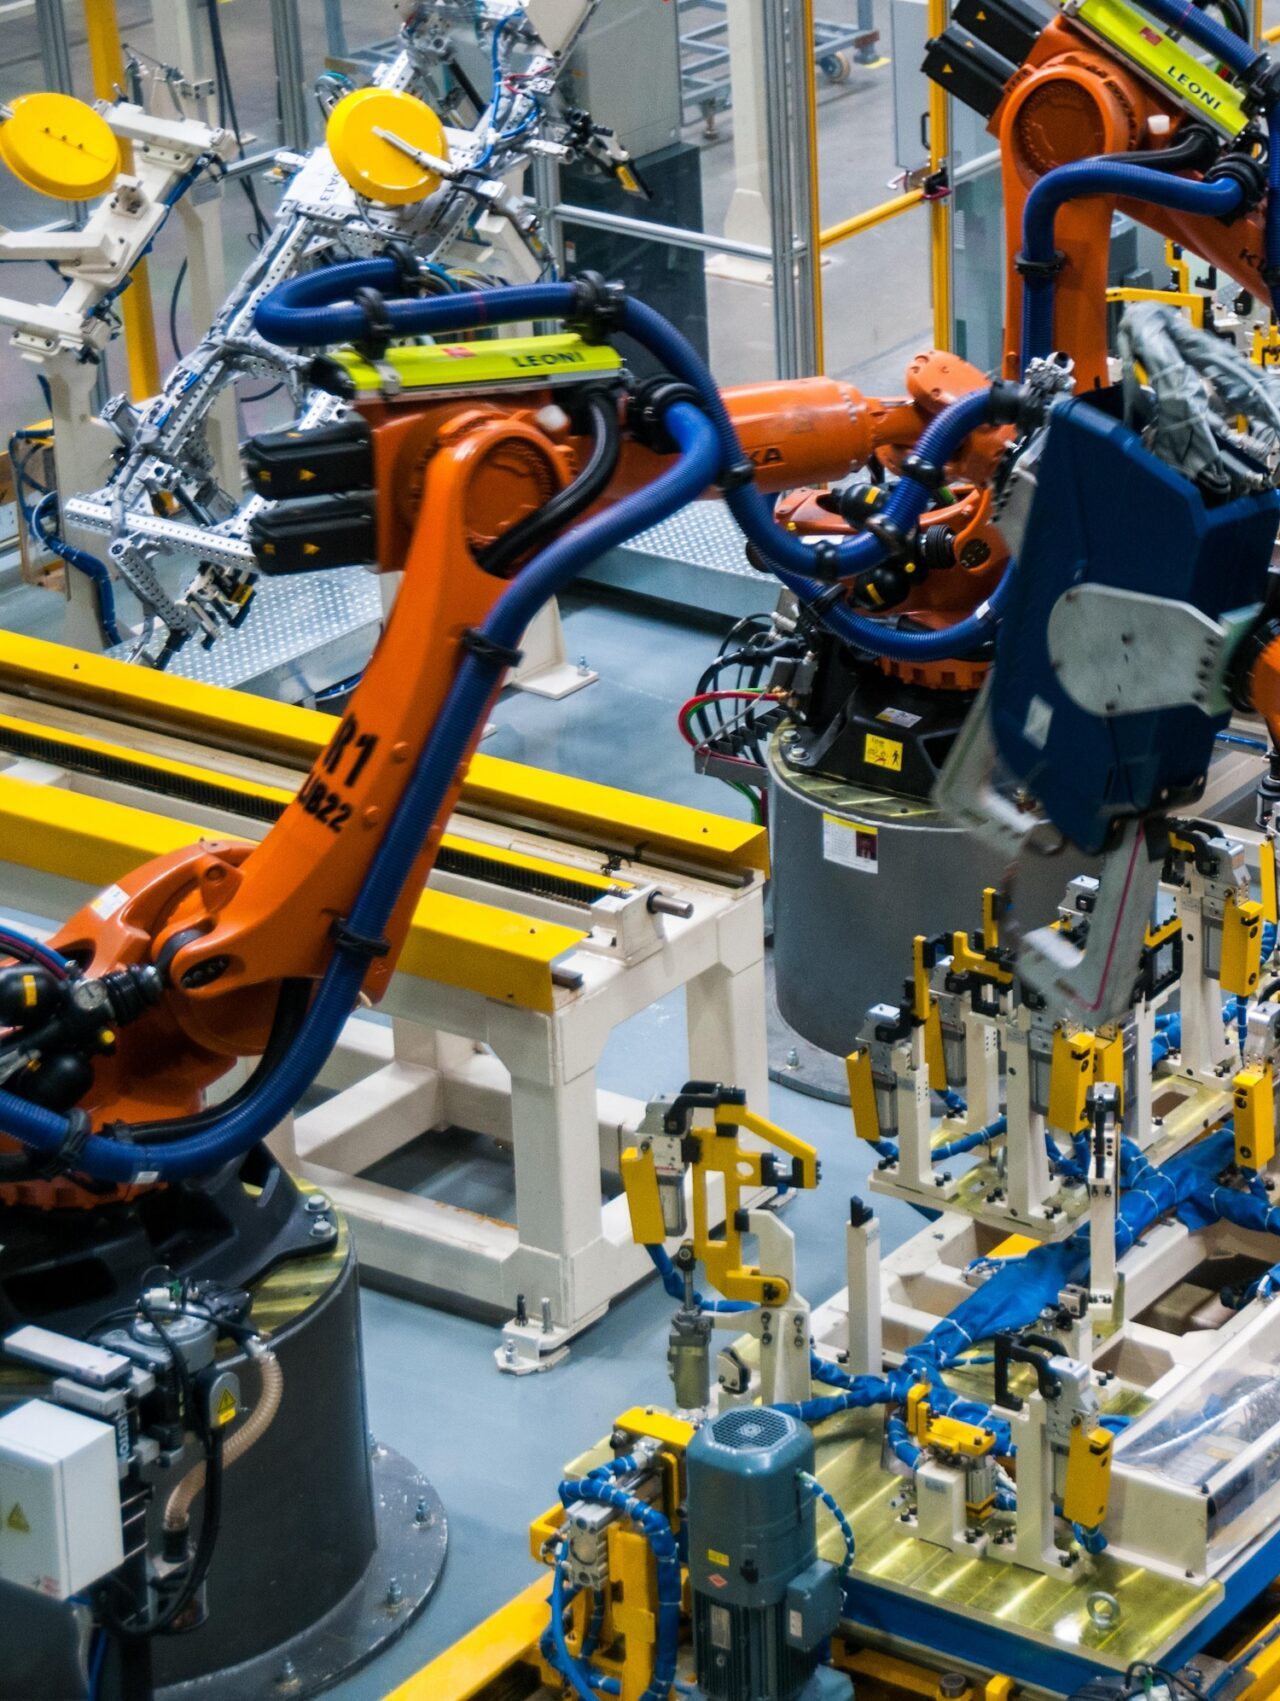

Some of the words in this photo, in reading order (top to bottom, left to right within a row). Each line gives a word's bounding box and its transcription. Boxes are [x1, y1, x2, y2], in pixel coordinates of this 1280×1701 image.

[1167, 65, 1221, 110] LEONI
[511, 351, 585, 368] LEONI
[323, 712, 379, 788] R1
